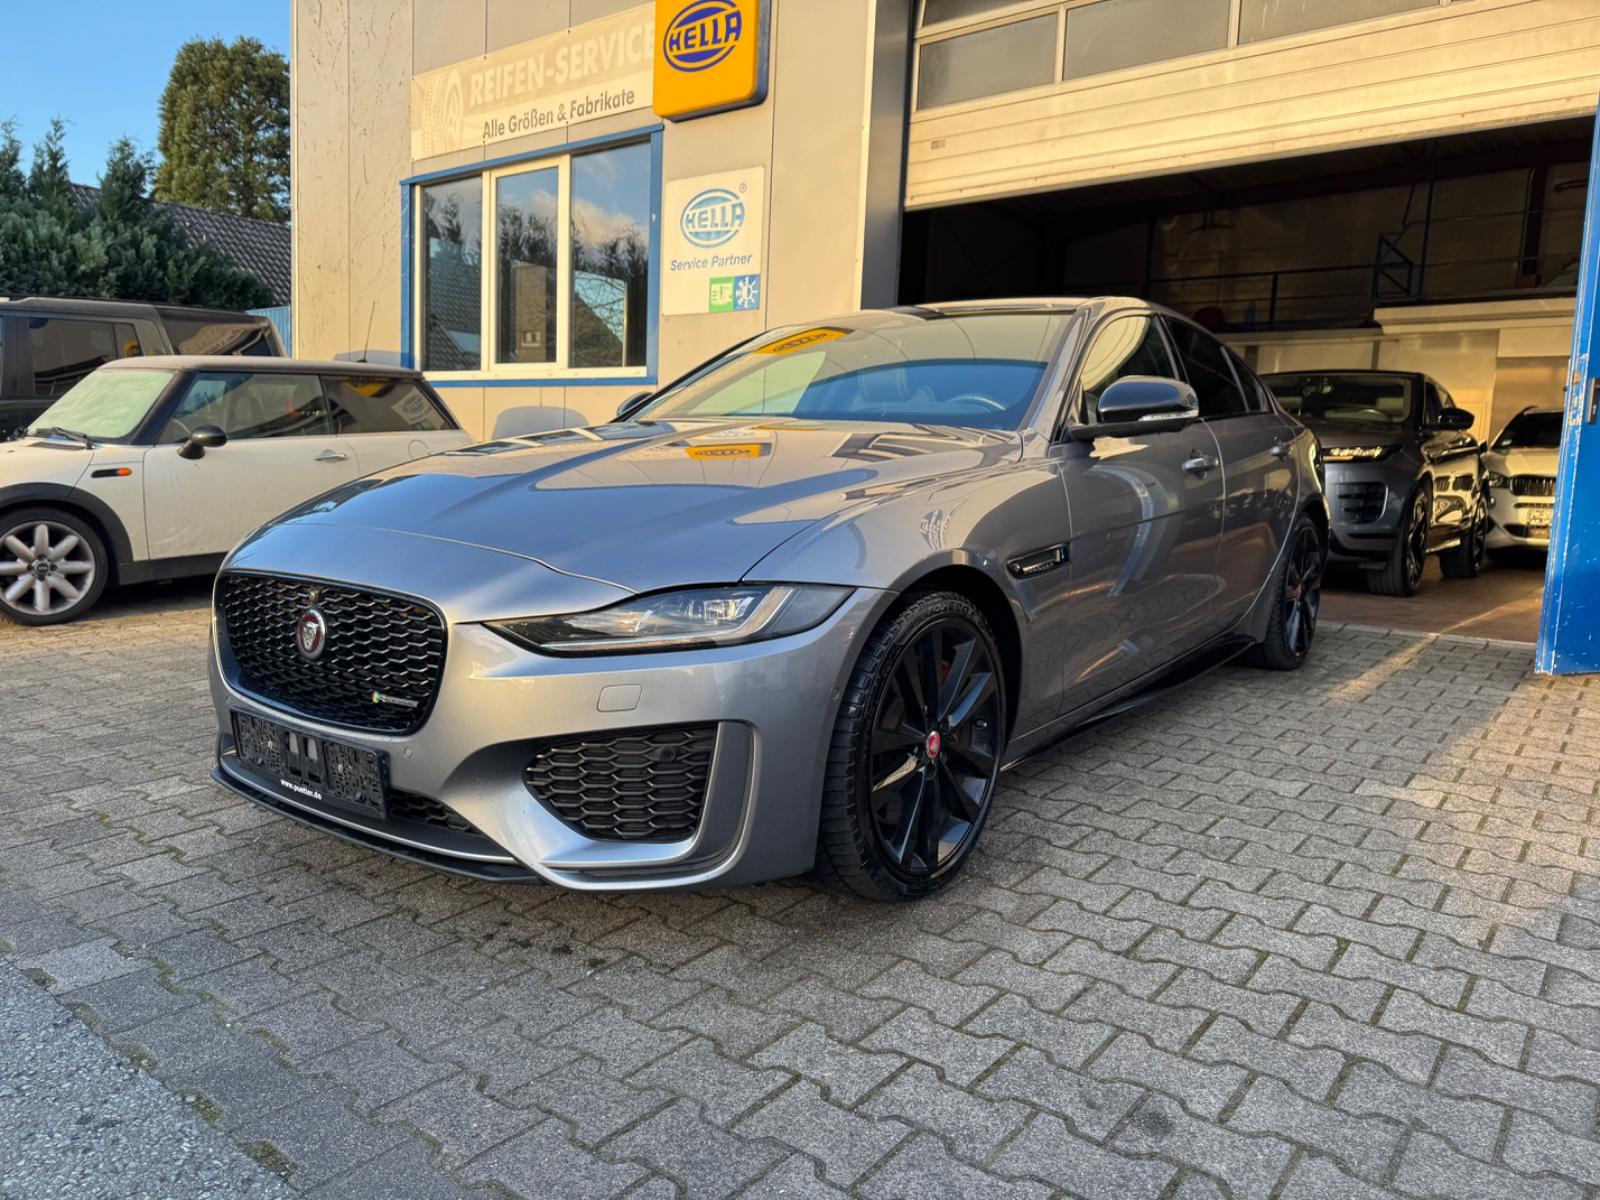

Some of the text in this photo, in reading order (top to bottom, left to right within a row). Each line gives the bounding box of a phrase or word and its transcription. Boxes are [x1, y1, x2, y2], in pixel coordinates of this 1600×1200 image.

[668, 9, 742, 53] HELLA
[469, 22, 655, 107] REIFEN-SERVICE
[482, 89, 635, 139] Alle Größen & Fabrikate
[685, 202, 745, 230] HELLA
[670, 253, 753, 271] Service Partner
